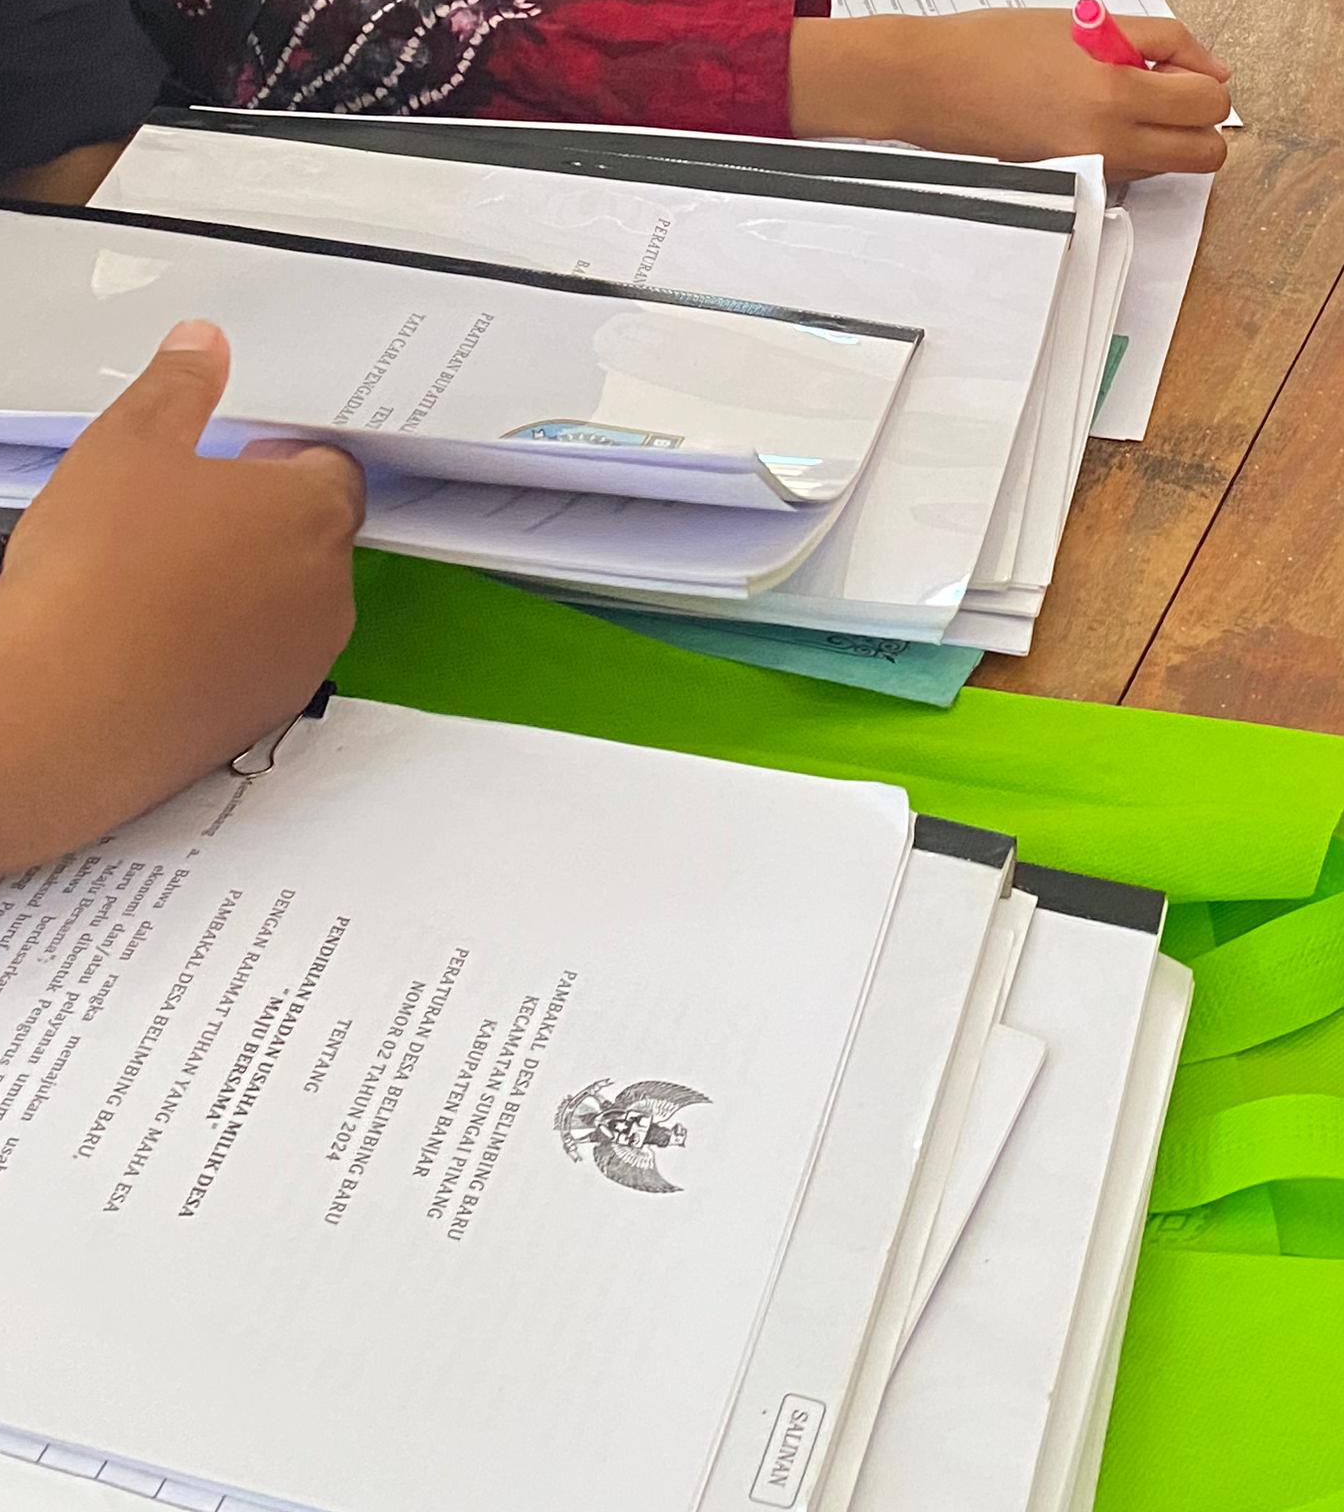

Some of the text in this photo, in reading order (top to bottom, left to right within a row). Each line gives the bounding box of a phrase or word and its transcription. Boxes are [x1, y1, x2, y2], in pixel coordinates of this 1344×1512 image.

[633, 218, 671, 286] PERATURAN
[377, 337, 407, 366] CARA
[398, 313, 427, 338] TATA
[446, 312, 494, 372] PERATURAN
[418, 371, 454, 409] BUPATI
[61, 856, 101, 893] Bahwa
[114, 862, 146, 890] Baru
[121, 864, 164, 917] ekonomi
[152, 868, 190, 908] Bahwa
[88, 895, 117, 927] perlu
[118, 920, 153, 960] dalam
[45, 932, 93, 992] dibentuk
[77, 923, 125, 983] dan/atau
[27, 991, 80, 1064] pelayanan
[72, 889, 242, 1158] PAMBAKAL DESA BELIMBING BARU,
[81, 973, 119, 1021] rangka
[251, 996, 283, 1040] MAJU
[20, 1035, 80, 1121] memajukan
[102, 889, 295, 1211] DENGAN RAHMAT TUHAN YANG MAHA ESA
[178, 916, 350, 1216] PENDIRIAN BADAN USAHA MILIK DESA
[303, 1019, 352, 1093] TENTANG
[325, 980, 426, 1160] NOMOR 02 TAHUN 2024
[205, 1041, 259, 1128] BERSAMA"
[324, 947, 469, 1224] PERATURAN DESA BELIMBING BARU
[412, 1018, 497, 1176] KABUPATEN BANJAR
[426, 995, 539, 1219] KECAMATAN SUNGAI PINANG
[447, 969, 577, 1240] PAMBAKAL DESA BELIMBING BARU
[768, 1409, 808, 1488] SALINAN
